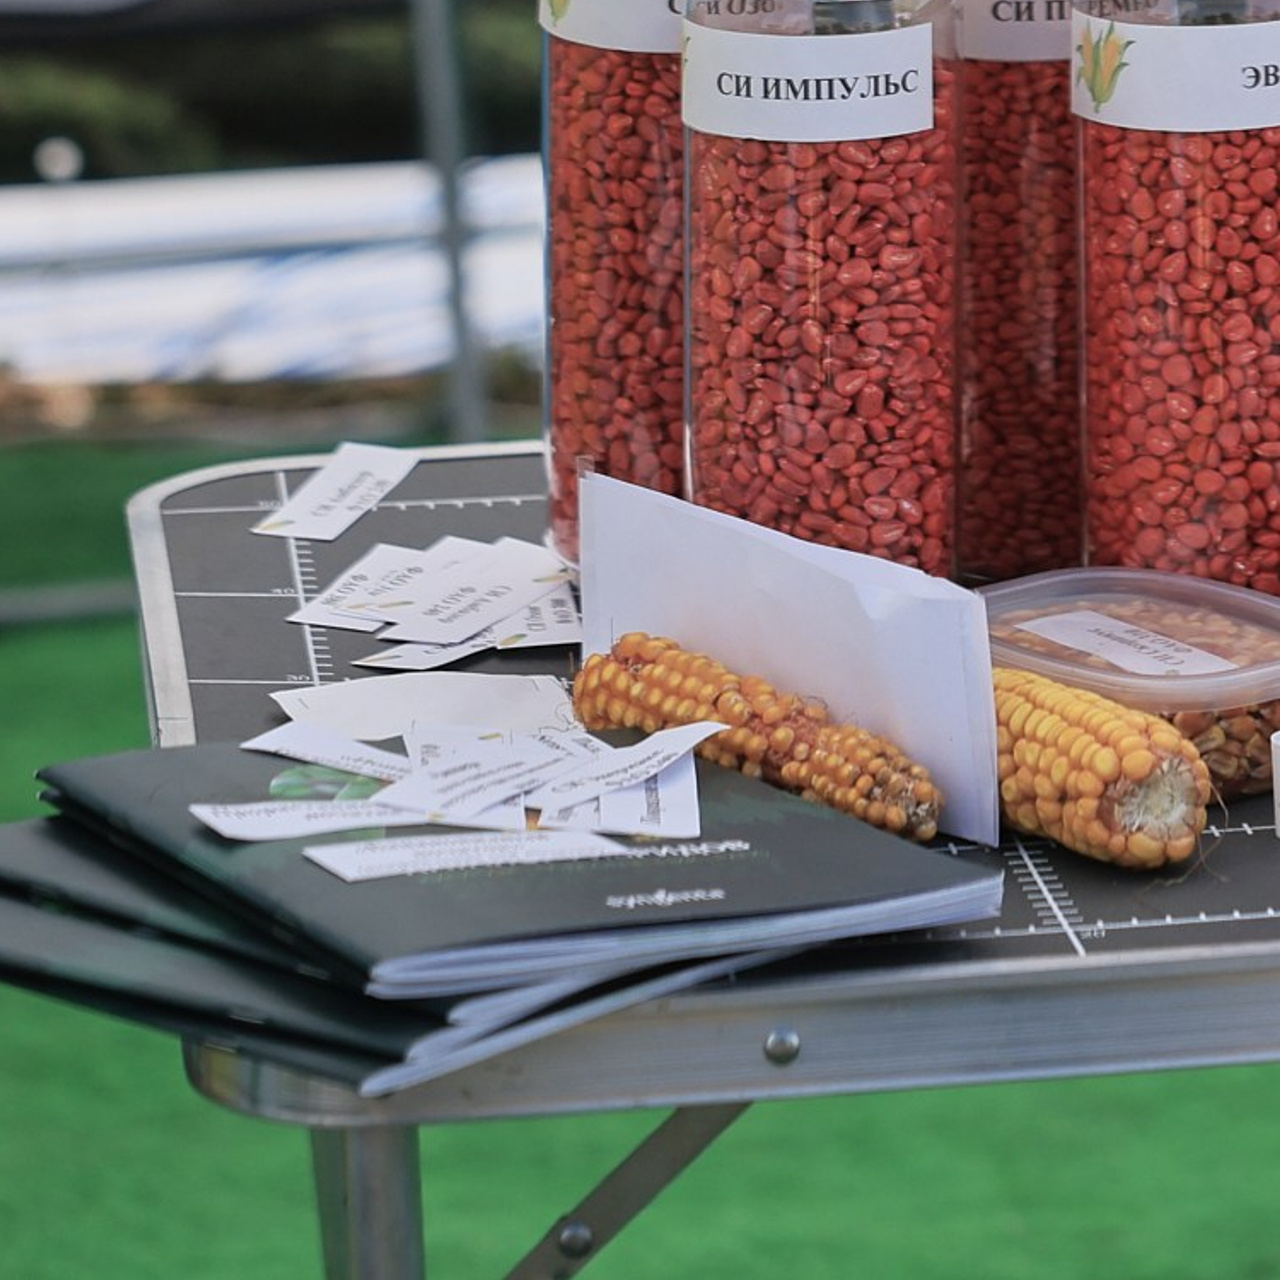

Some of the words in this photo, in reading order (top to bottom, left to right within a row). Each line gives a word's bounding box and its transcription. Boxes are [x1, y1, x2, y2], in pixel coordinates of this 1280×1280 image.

[988, 0, 1036, 22] СИ
[716, 71, 754, 97] СИ
[761, 68, 920, 102] ИМПУЛЬС
